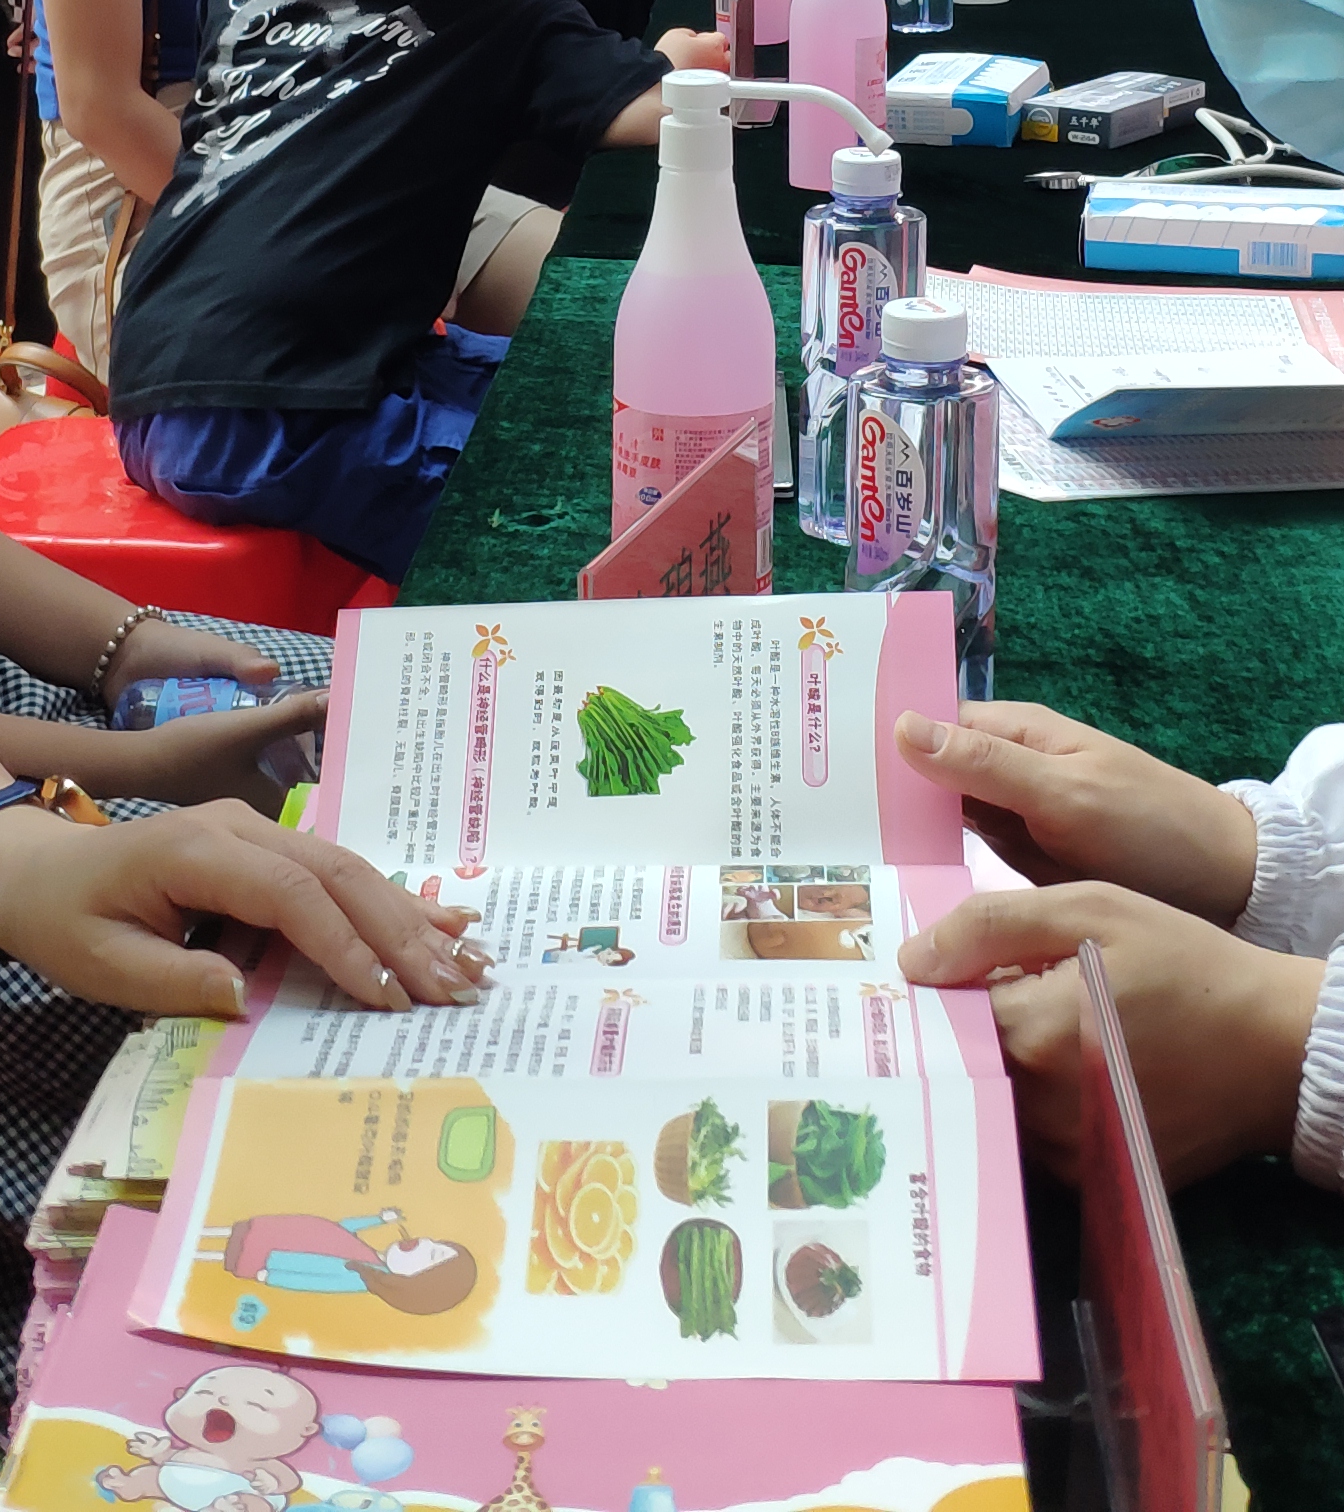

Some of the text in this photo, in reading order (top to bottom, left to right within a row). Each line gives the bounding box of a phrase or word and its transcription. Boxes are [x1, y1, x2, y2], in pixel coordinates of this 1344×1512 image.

[859, 415, 886, 545] Ganten
[894, 469, 913, 536] 百岁山
[806, 671, 823, 755] 叶酸是什么?
[909, 1171, 934, 1278] 富含叶酸的食物
